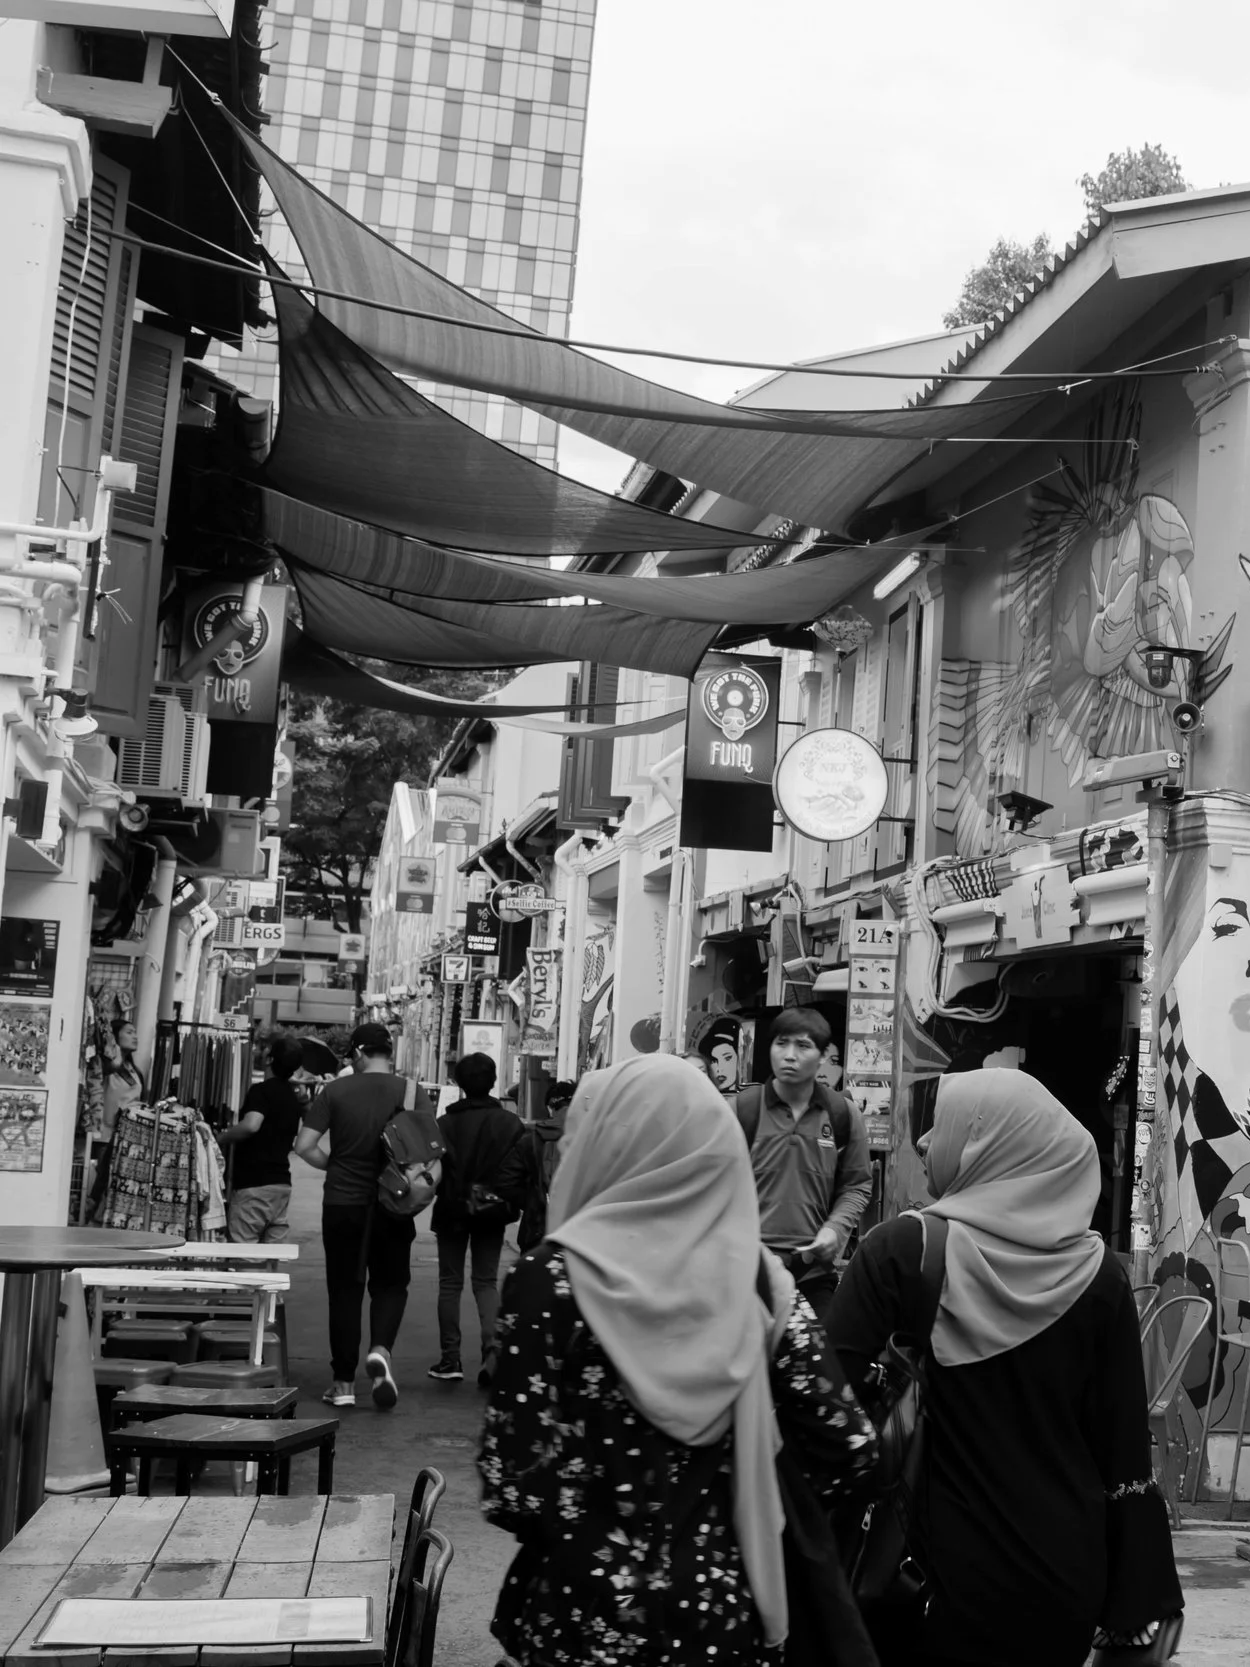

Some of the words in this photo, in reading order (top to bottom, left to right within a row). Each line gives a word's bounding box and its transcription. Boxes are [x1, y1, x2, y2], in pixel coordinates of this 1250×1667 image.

[711, 673, 730, 693] GOT
[731, 672, 753, 686] THE
[709, 692, 720, 711] WE
[709, 740, 754, 774] FUNQ
